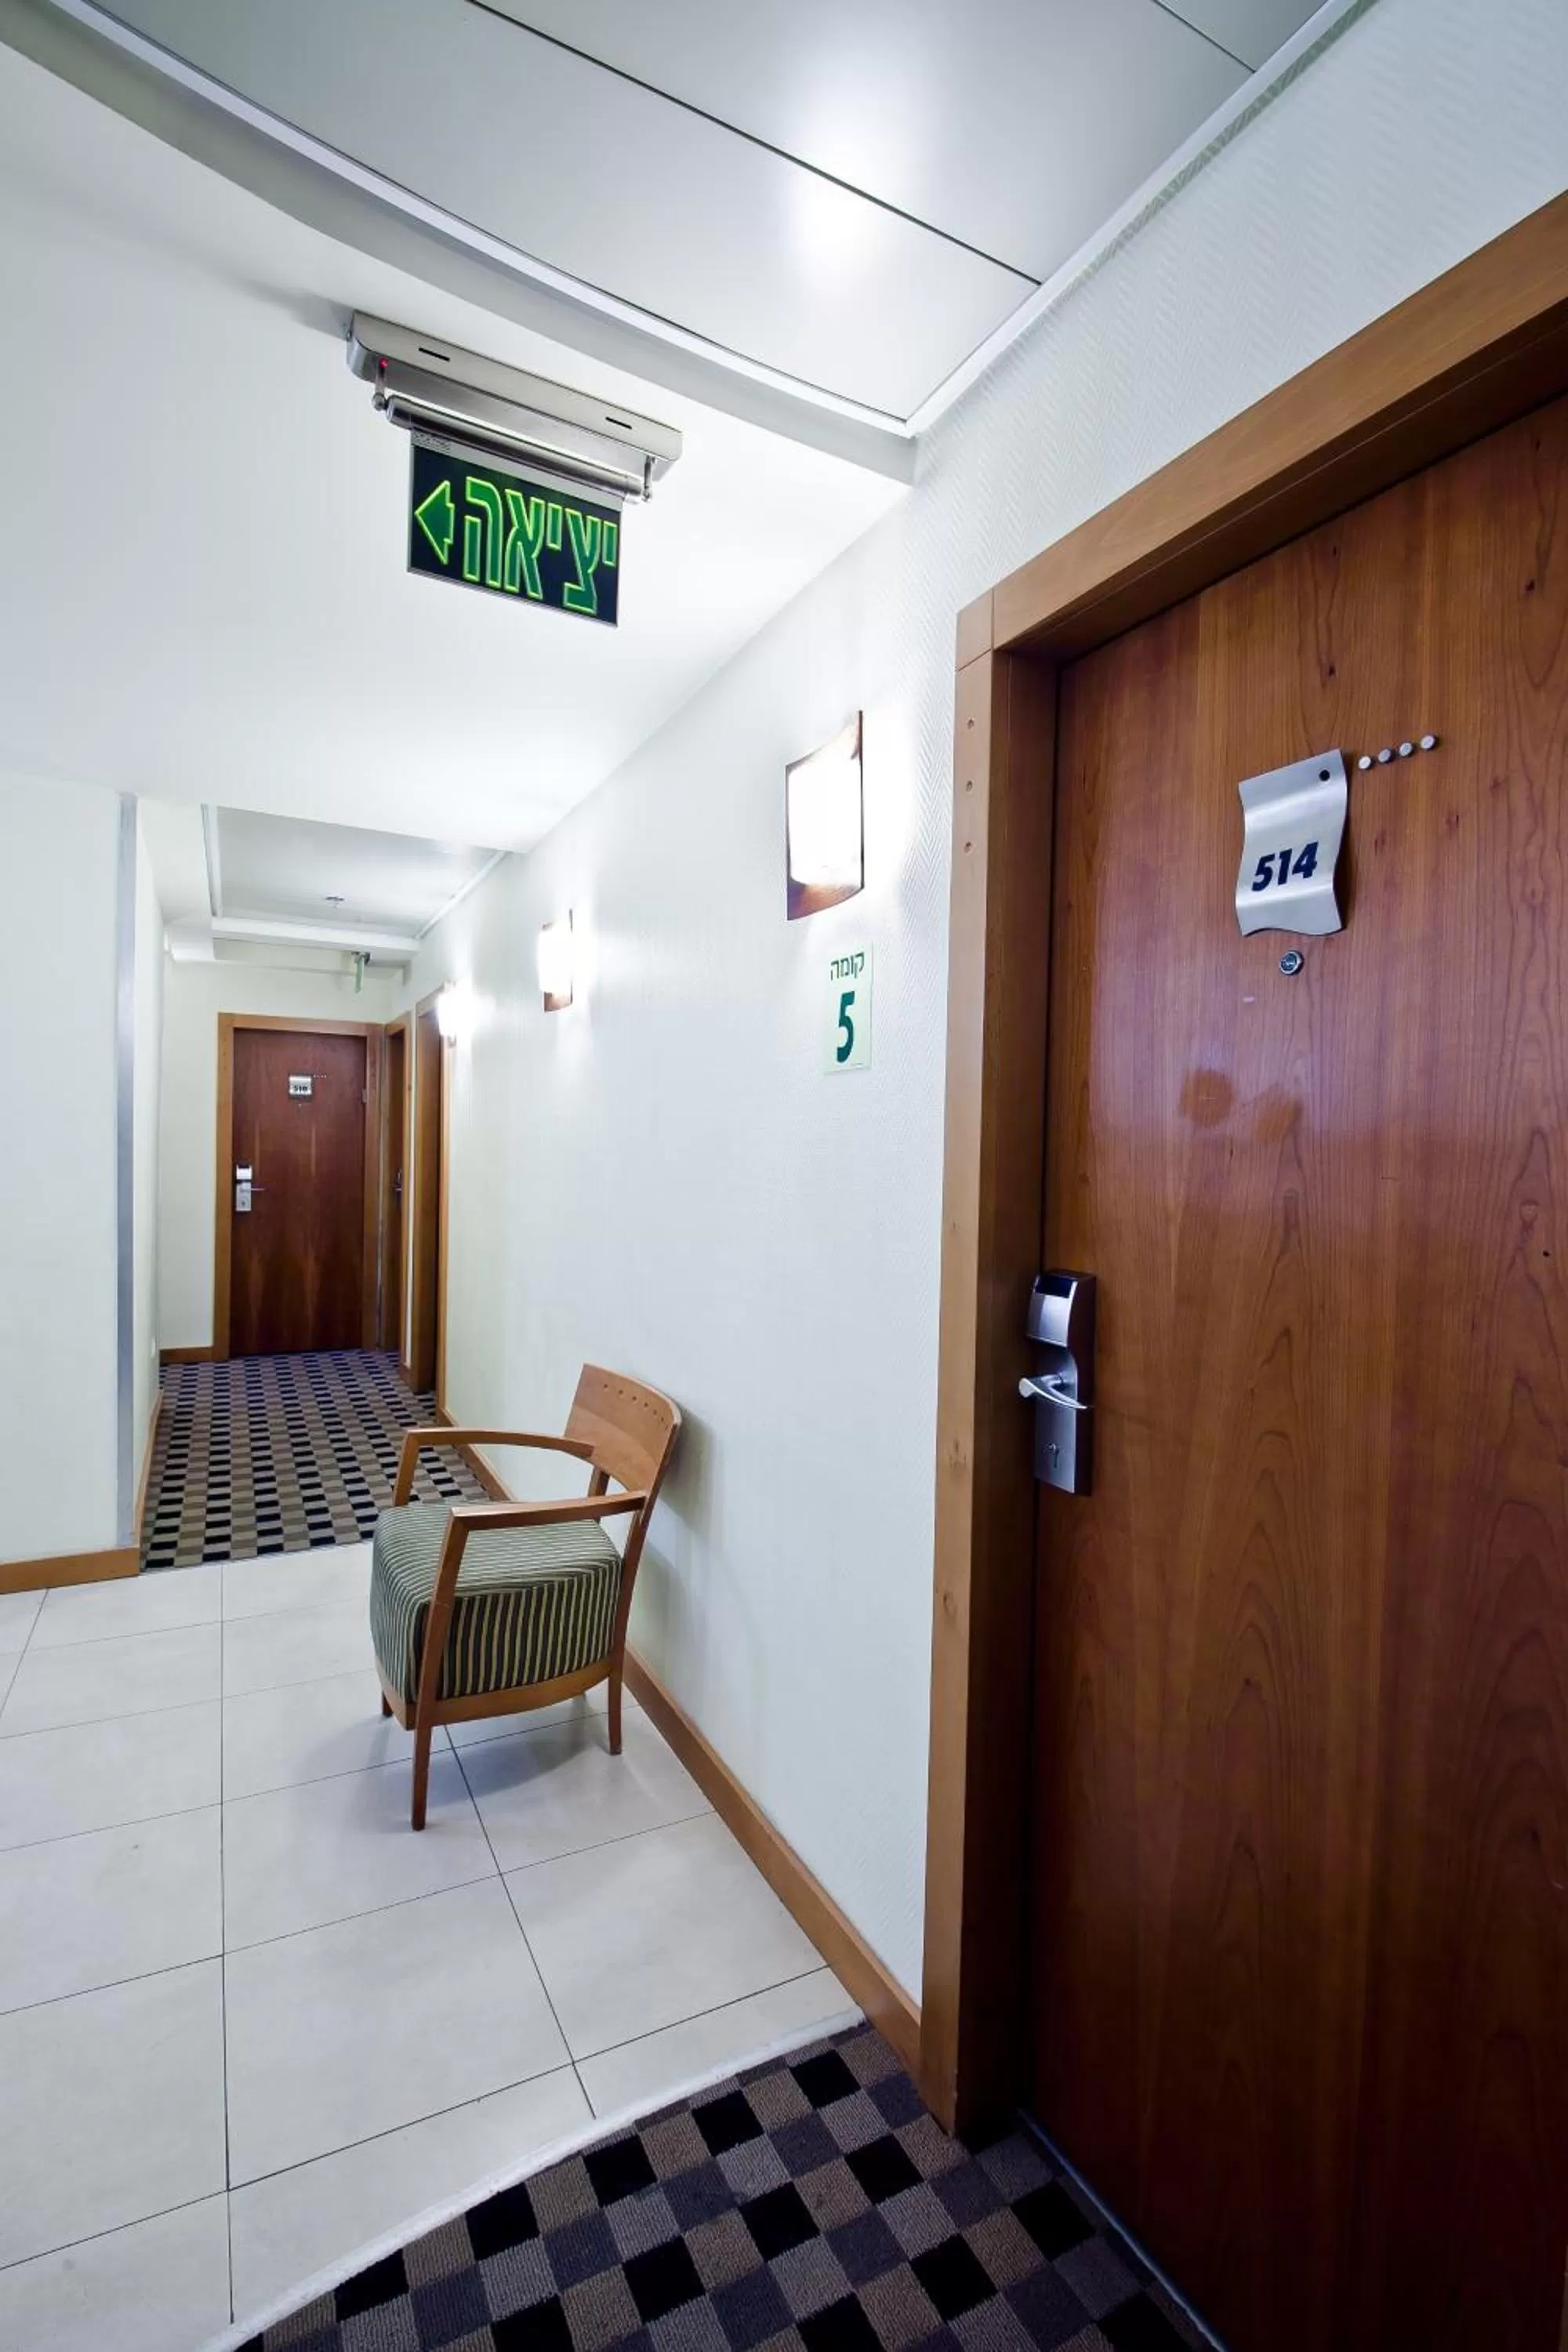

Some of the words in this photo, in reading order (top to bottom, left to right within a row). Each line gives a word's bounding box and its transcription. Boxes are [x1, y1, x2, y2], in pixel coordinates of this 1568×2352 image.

[463, 475, 618, 615] יציאה
[1251, 840, 1319, 891] 514
[829, 951, 865, 981] קומה
[837, 990, 855, 1063] 5
